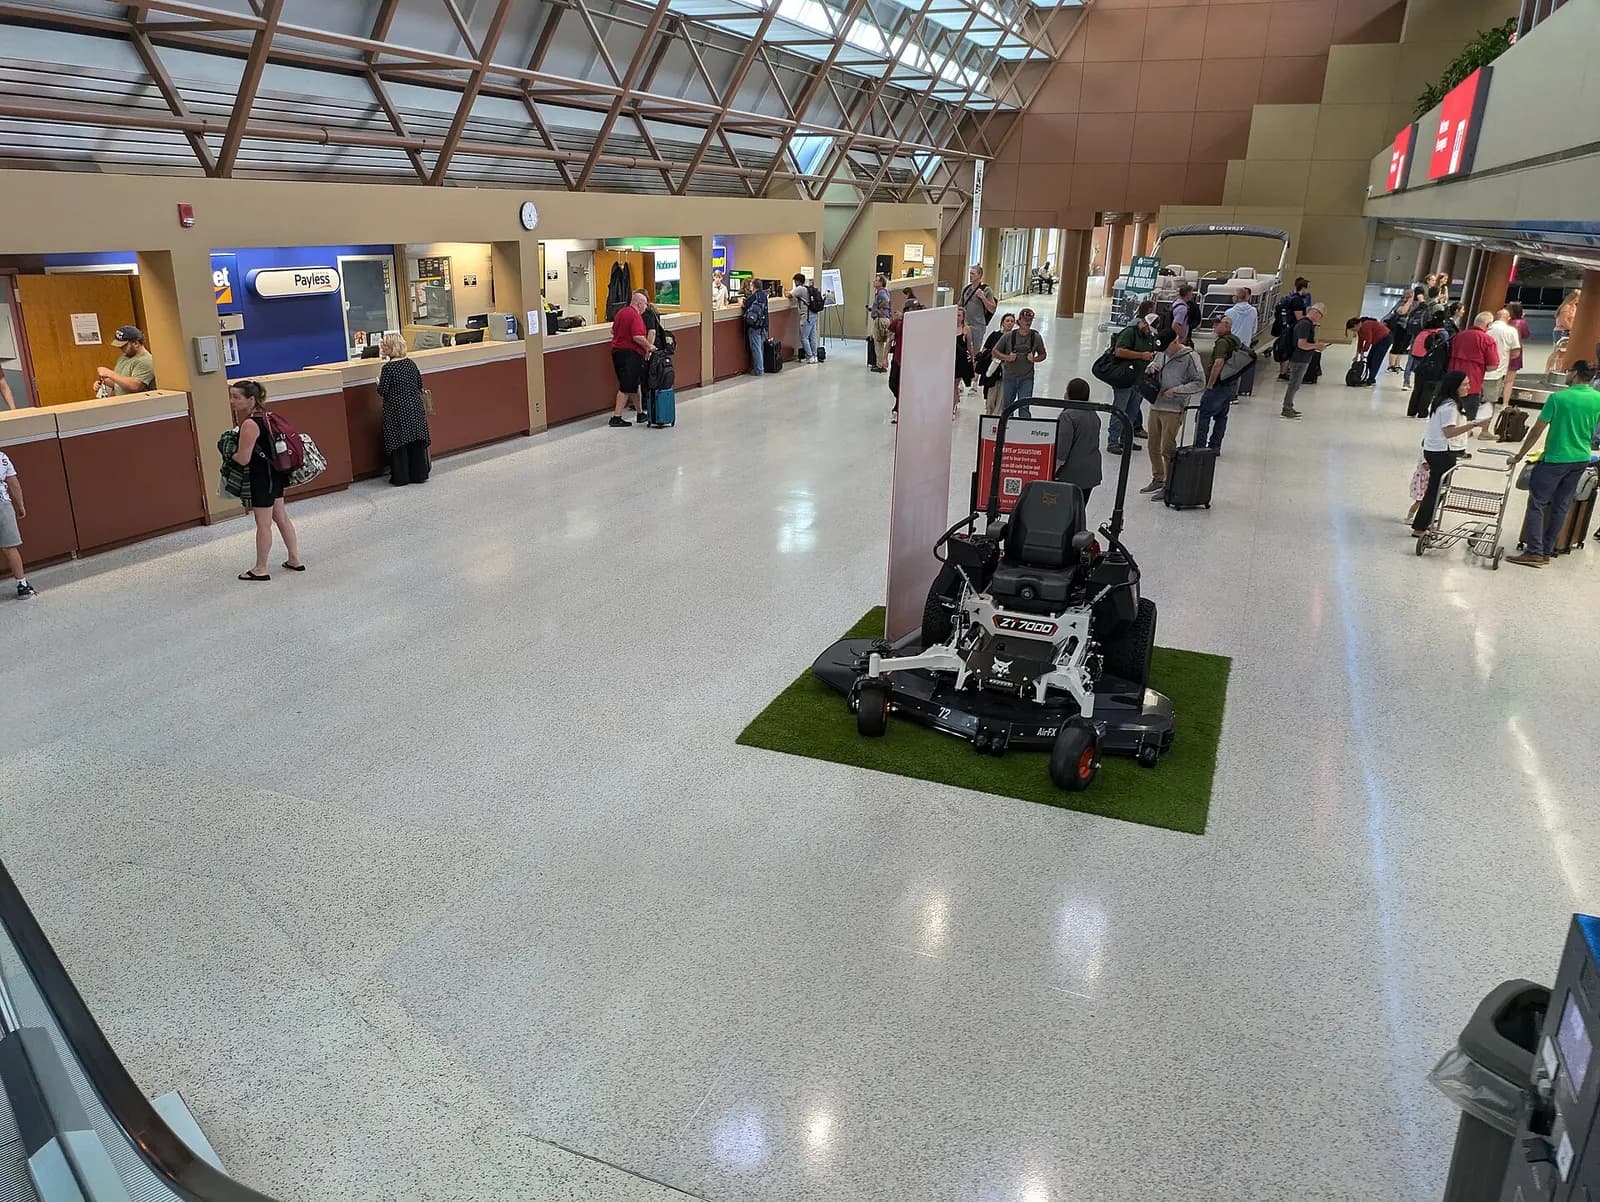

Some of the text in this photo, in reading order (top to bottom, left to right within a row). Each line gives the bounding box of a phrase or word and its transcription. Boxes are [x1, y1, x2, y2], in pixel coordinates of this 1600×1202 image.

[656, 259, 678, 270] National
[294, 273, 331, 288] Payless
[1018, 620, 1054, 633] 7000
[938, 706, 952, 720] 72
[1036, 727, 1058, 737] AirFX
